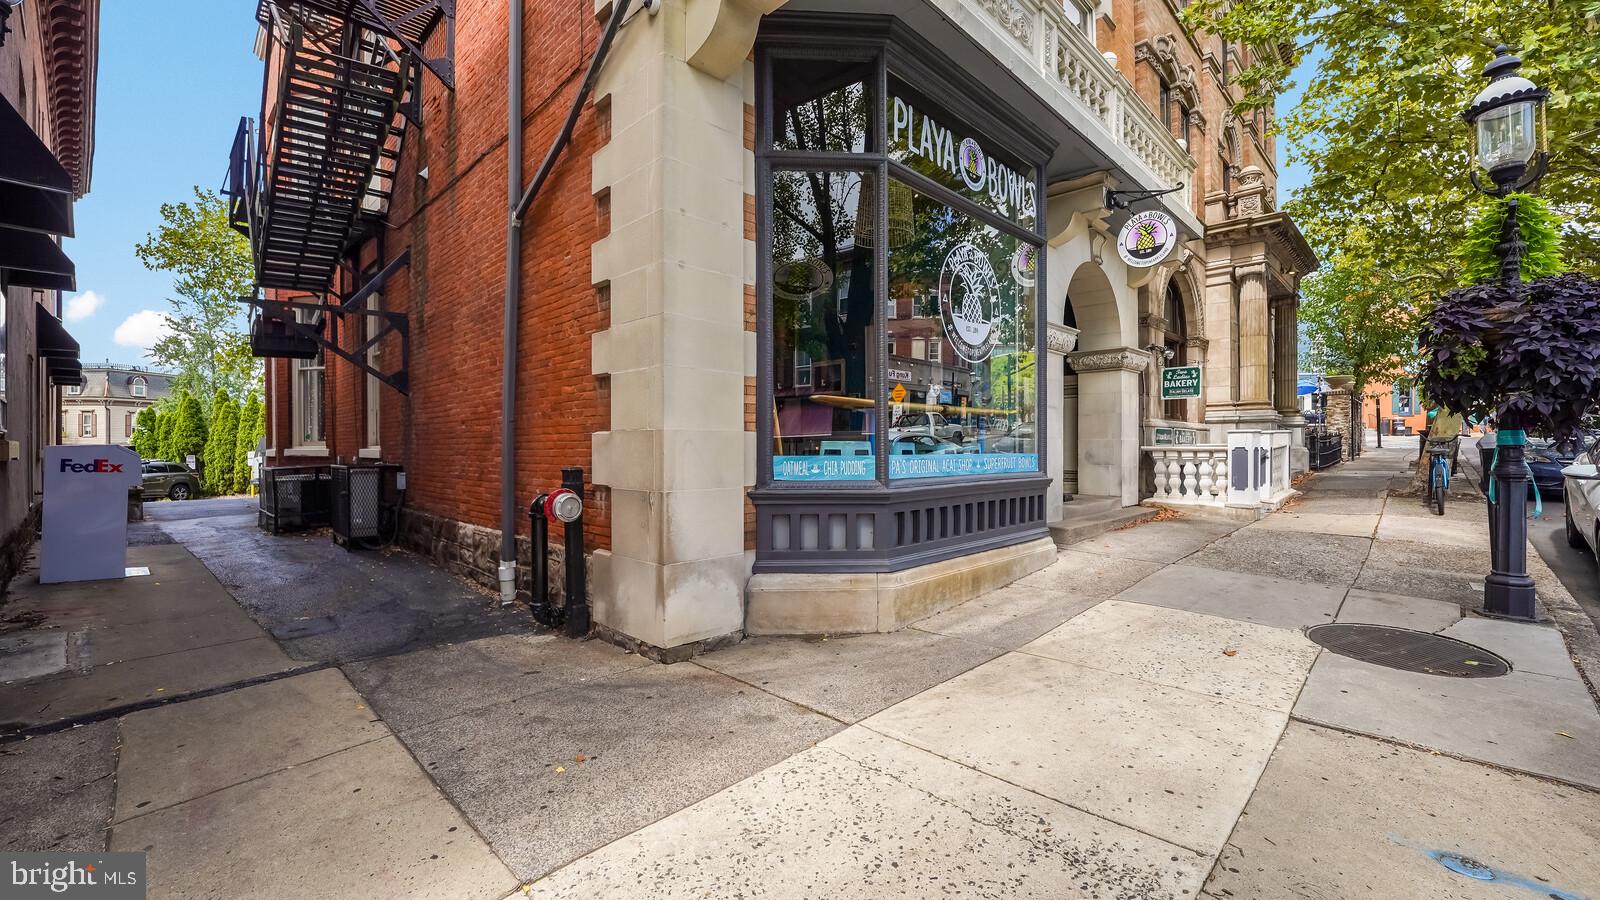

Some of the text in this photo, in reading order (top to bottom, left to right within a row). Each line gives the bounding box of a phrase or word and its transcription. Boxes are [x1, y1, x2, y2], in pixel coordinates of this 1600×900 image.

[893, 96, 1037, 219] PLAYA BOWLS
[1124, 211, 1171, 230] PLAYA BOWLS
[1164, 379, 1198, 388] BAKERY
[60, 458, 124, 473] FedEx
[782, 460, 866, 476] OATMEAL CHIA PUDDING
[891, 459, 906, 475] PA'S
[909, 459, 940, 474] ORIGINAL
[958, 458, 973, 472] SHOP
[984, 456, 1016, 470] SUPERFRUIT
